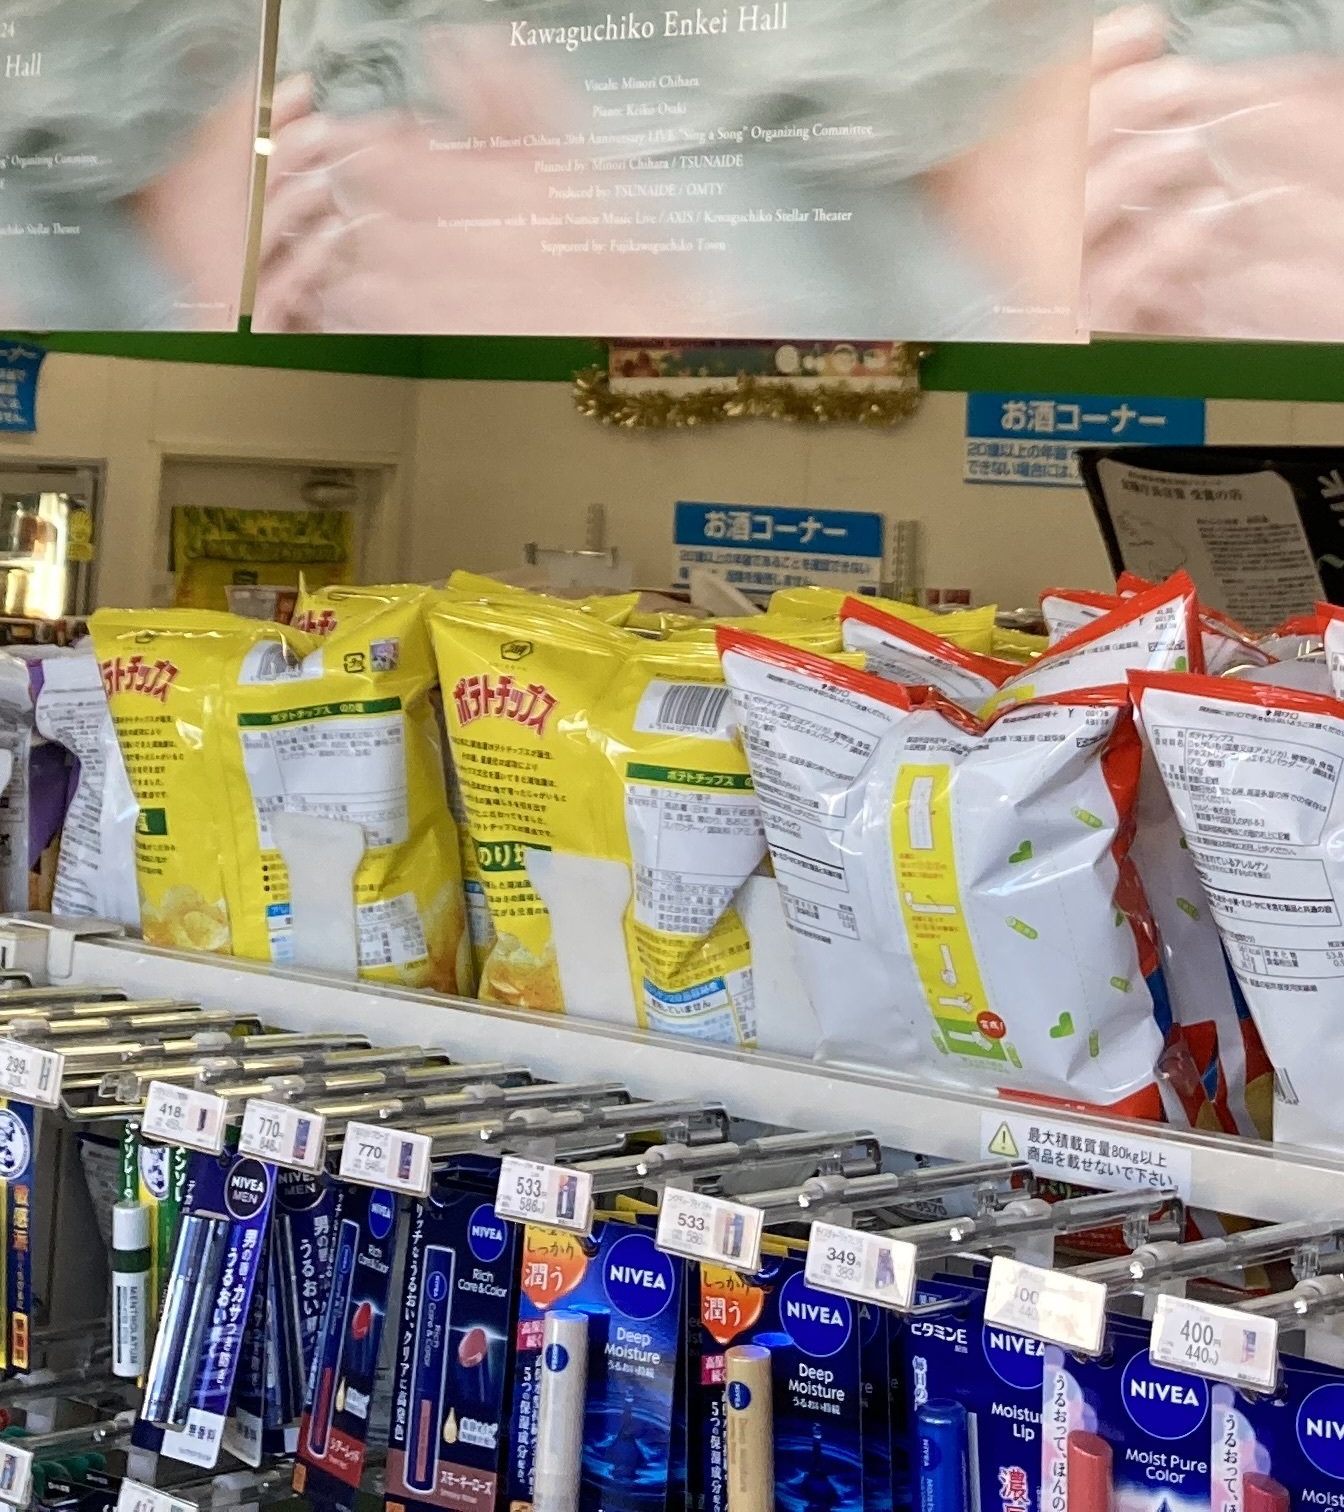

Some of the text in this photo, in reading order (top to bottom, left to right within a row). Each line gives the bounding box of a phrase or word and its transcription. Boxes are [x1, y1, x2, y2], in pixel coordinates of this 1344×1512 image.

[510, 2, 788, 50] Kawaguchiko Enkei Hall
[5, 52, 43, 78] Hall
[751, 124, 873, 140] Organizing Committee
[680, 154, 743, 168] TSUNAIDE
[775, 208, 852, 221] Stellar Theater
[1001, 401, 1167, 436] お酒コーナー
[704, 511, 848, 544] お酒コーナー
[102, 655, 180, 704] テトチップス
[452, 673, 560, 738] ポテトチップス
[666, 769, 736, 786] ポテトチップス
[1028, 1127, 1167, 1168] 最大積載質量80kg以上
[1027, 1145, 1179, 1188] 商品を載せないで下さい。
[231, 1175, 264, 1194] NIVEA
[232, 1191, 258, 1205] MEN
[471, 1225, 502, 1241] NIVEA
[472, 1269, 494, 1283] Rich
[524, 1261, 563, 1291] 潤う
[610, 1264, 666, 1290] NIVEA
[704, 1295, 742, 1326] 潤う
[786, 1300, 844, 1327] NIVEA
[616, 1327, 651, 1347] Deep
[604, 1343, 660, 1365] Moisture
[798, 1363, 834, 1384] Deep
[788, 1379, 846, 1402] Moisture
[1130, 1378, 1199, 1407] NIVEA
[1013, 1423, 1035, 1442] Lip
[1125, 1448, 1207, 1473] Moist Pure
[1145, 1466, 1186, 1484] Color
